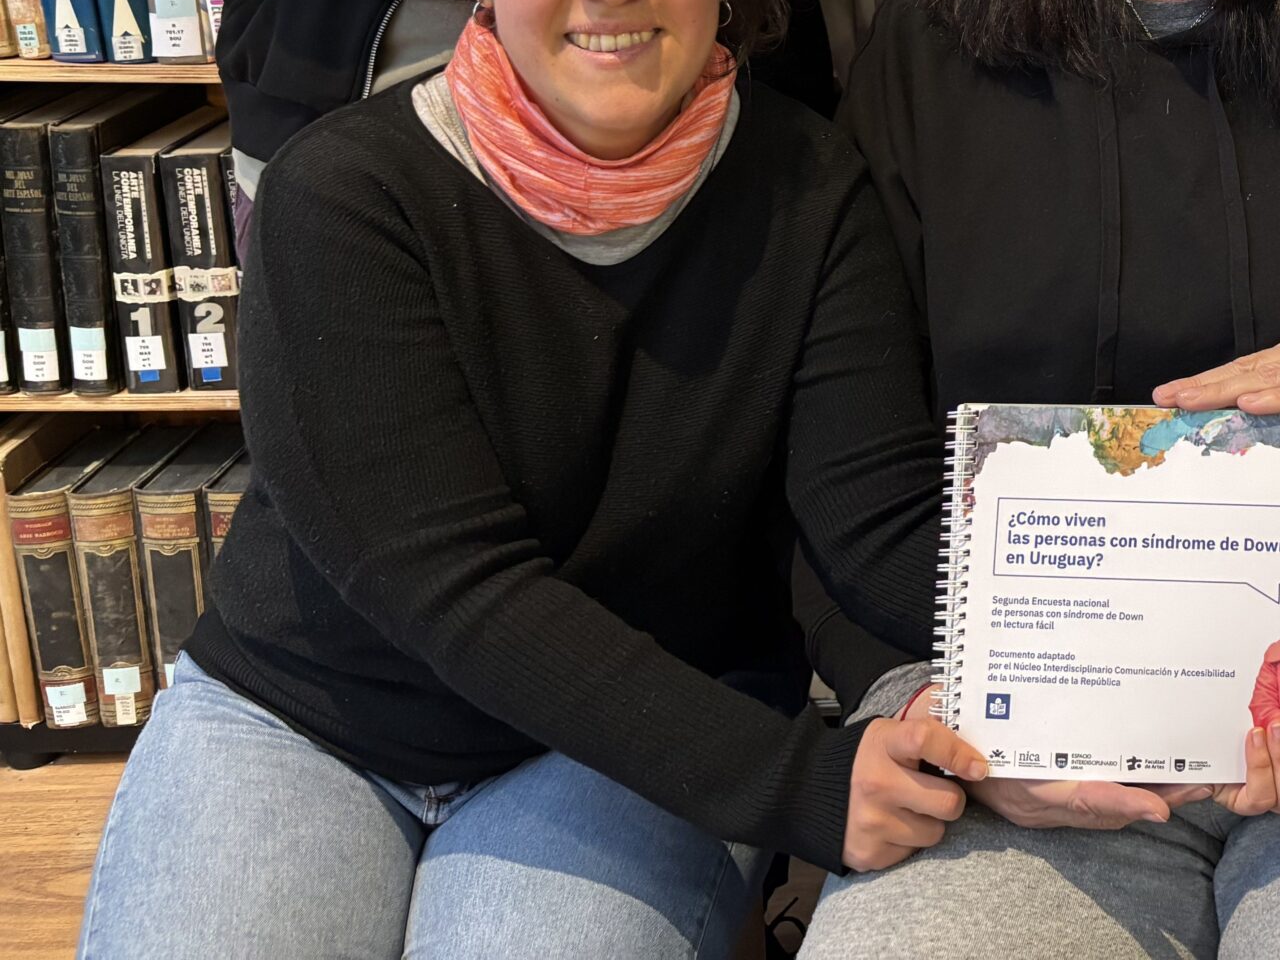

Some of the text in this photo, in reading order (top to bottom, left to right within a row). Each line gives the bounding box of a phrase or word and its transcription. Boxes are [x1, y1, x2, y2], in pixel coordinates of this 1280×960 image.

[129, 170, 140, 199] ARTE
[191, 167, 202, 195] ARTE
[119, 171, 138, 260] CONTEMPORANEA
[130, 306, 151, 336] 1
[193, 302, 226, 334] 2
[1008, 511, 1106, 528] ¿Cómo viven
[1008, 530, 1030, 546] las
[1034, 534, 1106, 550] personas
[1110, 536, 1138, 548] con
[1141, 534, 1216, 551] síndrome
[1220, 537, 1239, 551] de
[1006, 551, 1104, 570] en Uruguay?
[992, 595, 1110, 608] Segunda Encuesta nacional
[991, 608, 1144, 621] de personas con síndrome de Down
[991, 619, 1055, 630] en lectura fácil
[989, 650, 1076, 661] Documento adaptado
[988, 661, 1236, 678] por el Núcleo Interdisciplinario Comunicación y Accesibilidad
[987, 673, 1121, 687] de la Universidad de la República
[1018, 750, 1040, 762] nica
